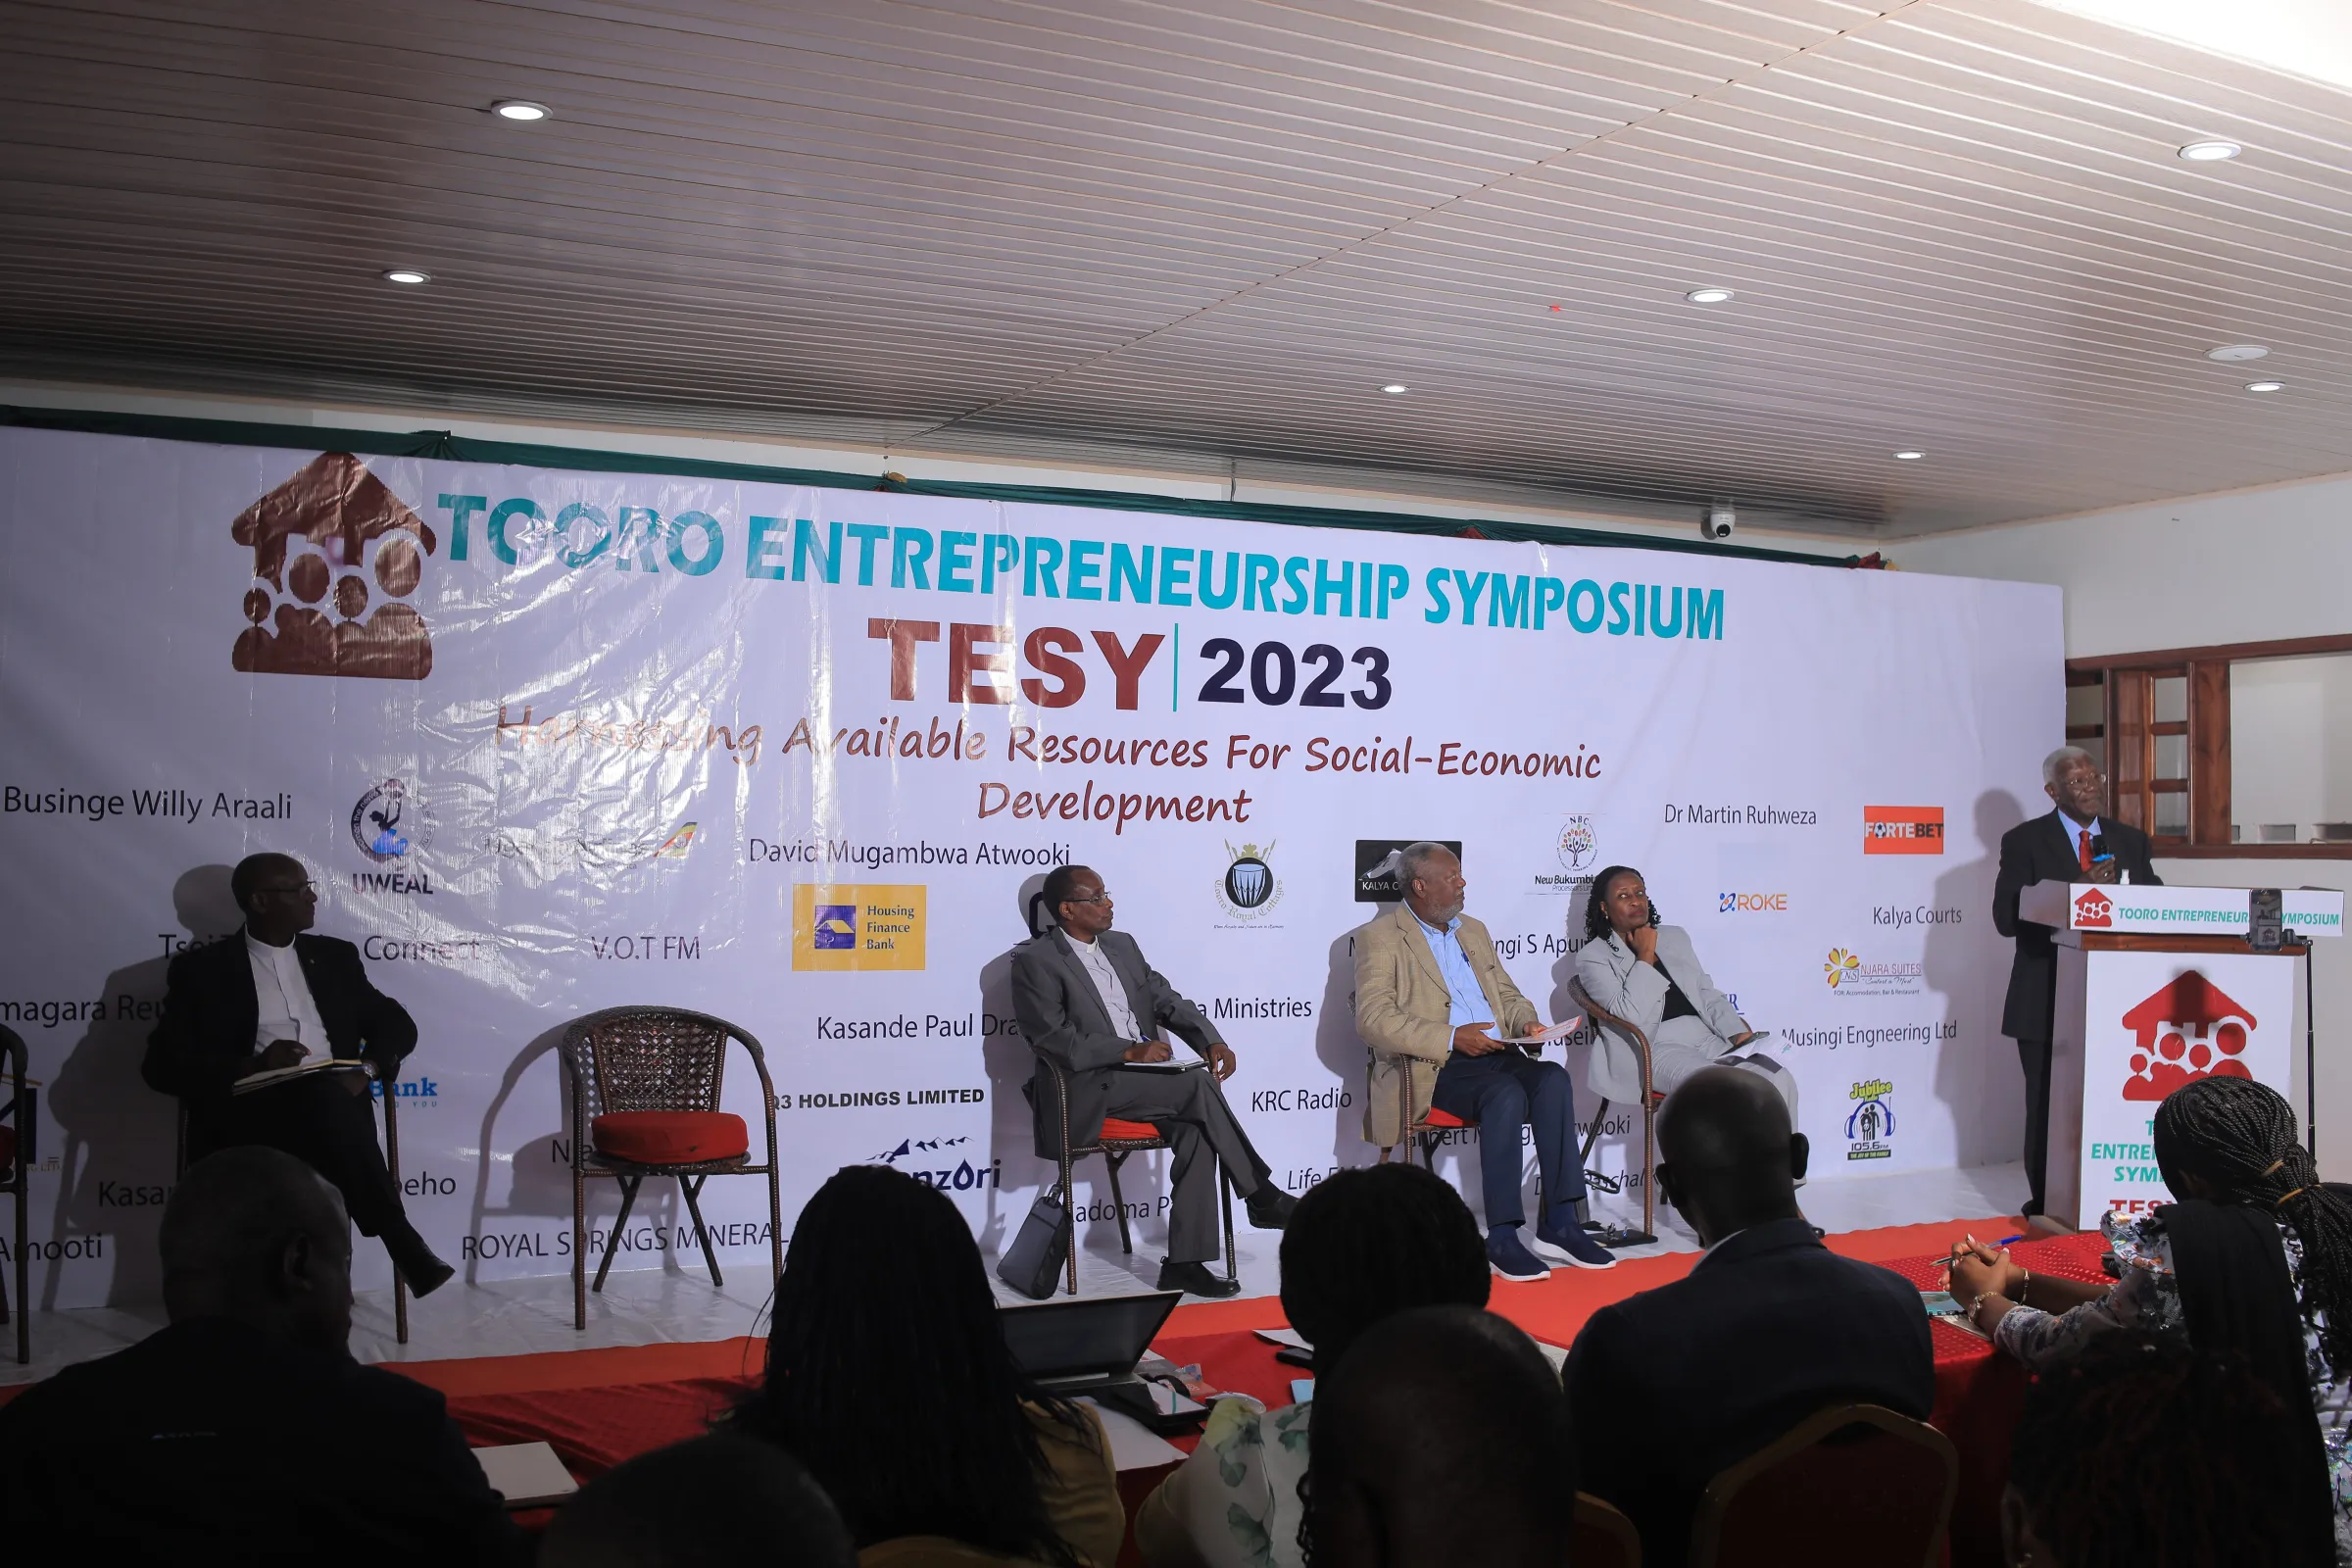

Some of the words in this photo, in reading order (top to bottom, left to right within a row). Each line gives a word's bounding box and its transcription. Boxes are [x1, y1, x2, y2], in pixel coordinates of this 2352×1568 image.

[438, 493, 724, 576] TOORO
[746, 515, 1409, 621] ENTREPRENEURSHIP
[1424, 566, 1724, 640] SYMPOSIUM
[868, 617, 1166, 711] TESY
[1198, 638, 1392, 710] 2023
[783, 715, 987, 762] Available
[1008, 725, 1208, 770] Resources
[1226, 734, 1291, 770] For
[1305, 736, 1601, 779] Social-Economic
[4, 787, 124, 820] Businge
[132, 789, 203, 823] Willy
[212, 792, 292, 819] Araali
[978, 781, 1252, 835] Development
[1664, 804, 1683, 823] Dr
[1688, 805, 1741, 824] Martin
[1746, 806, 1817, 825] Ruhweza
[1569, 815, 1589, 825] NBC
[1864, 821, 1944, 839] FORTEBET
[749, 838, 818, 863] David
[827, 839, 968, 869] Mugambwa
[976, 842, 1070, 866] Atwooki
[353, 873, 433, 895] UWEAL
[1535, 875, 1553, 885] New
[867, 905, 915, 919] Housing
[1737, 893, 1788, 910] ROKE
[867, 921, 910, 933] Finance
[1873, 906, 1912, 930] Kalya
[1915, 906, 1962, 924] Courts
[2119, 907, 2159, 920] TOORO
[2161, 909, 2250, 923] ENTREPRENEUR
[2281, 912, 2339, 925] YMPOSIUM
[591, 936, 656, 961] V.O.T
[663, 935, 702, 960] FM
[866, 938, 895, 951] Bank
[1527, 934, 1538, 955] S
[1861, 963, 1889, 974] NJARA
[1891, 963, 1921, 974] SUITES
[1214, 997, 1312, 1019] Ministries
[817, 1015, 918, 1040] Kasande
[924, 1013, 973, 1039] Paul
[982, 1013, 1019, 1037] Dra
[1782, 1027, 1842, 1050] Musingi
[1846, 1023, 1931, 1048] Engneering
[1936, 1020, 1957, 1040] Ltd
[799, 1091, 901, 1109] HOLDINGS
[906, 1089, 985, 1105] LIMITED
[1251, 1090, 1291, 1112] KRC
[1298, 1088, 1352, 1110] Radio
[463, 1232, 549, 1260] ROYAL
[677, 1222, 789, 1249] MNERAL
